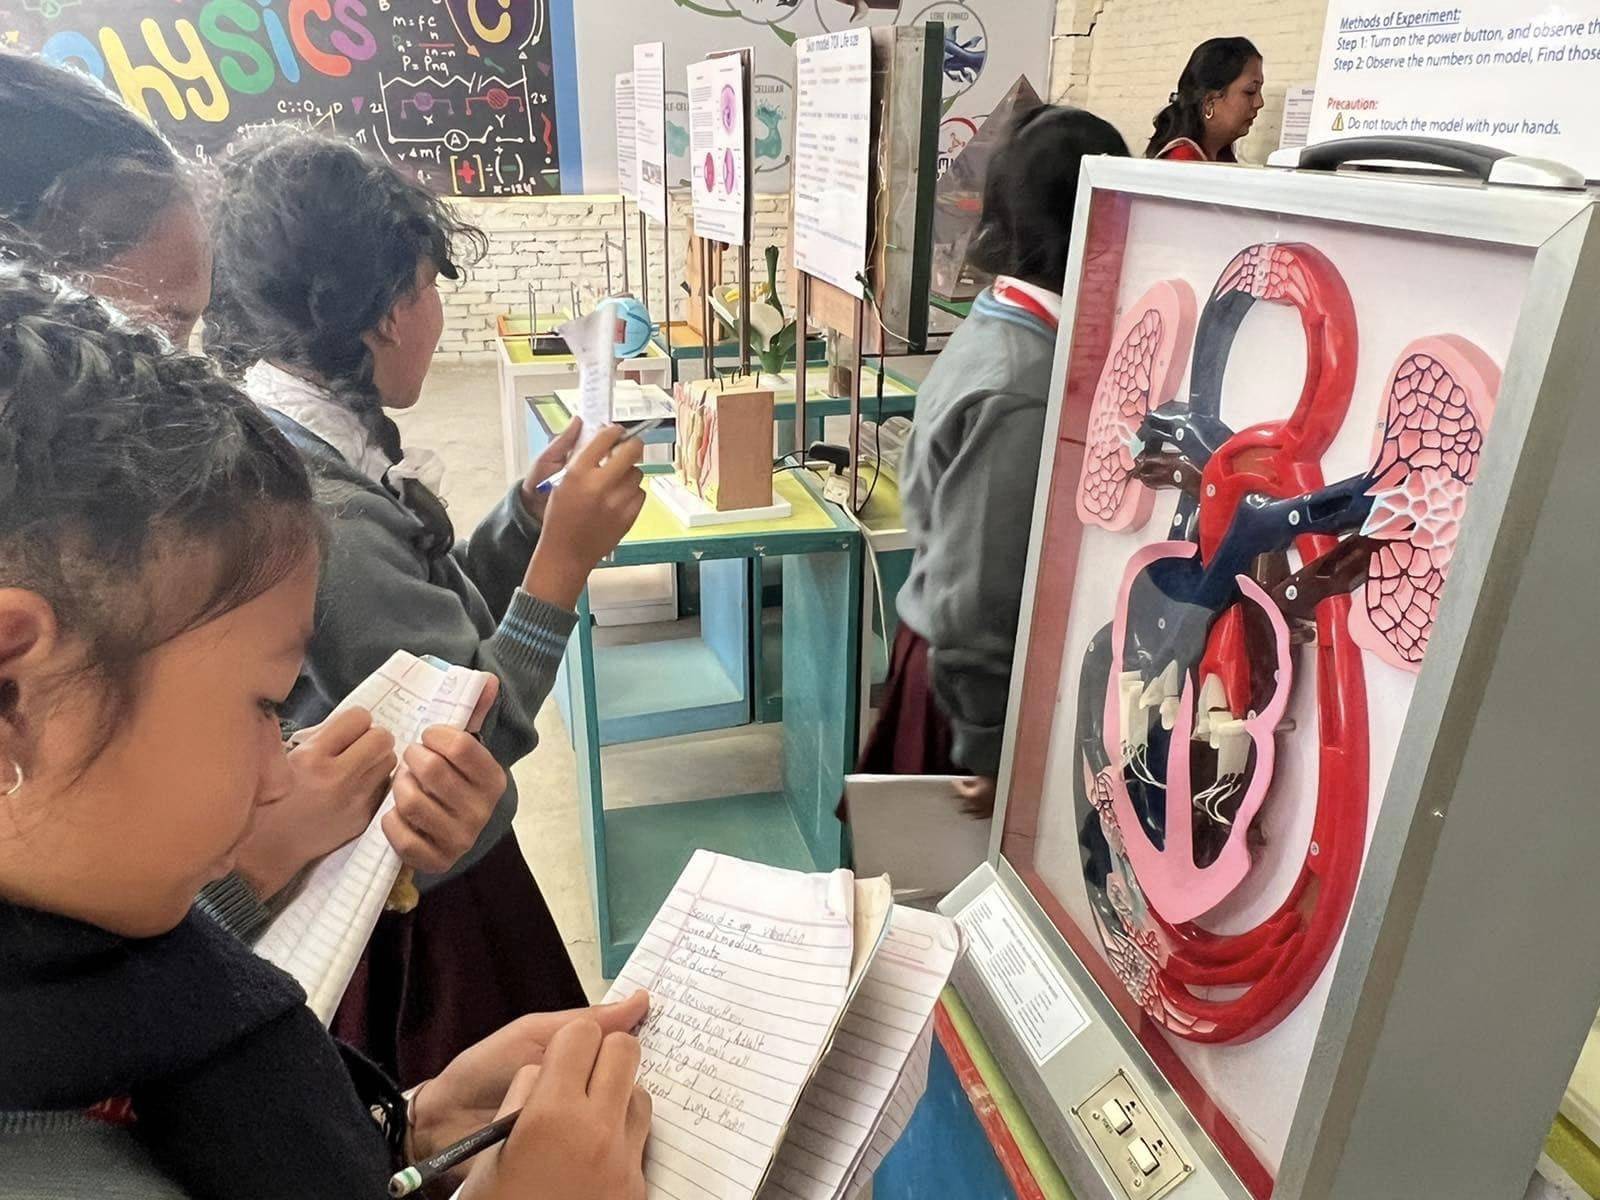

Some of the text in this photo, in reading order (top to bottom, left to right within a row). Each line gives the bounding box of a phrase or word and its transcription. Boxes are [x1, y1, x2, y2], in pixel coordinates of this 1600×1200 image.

[1340, 9, 1461, 30] Methods of Experiment:
[1337, 37, 1357, 51] Step
[1361, 36, 1368, 48] 1:
[1371, 35, 1391, 48] Turn
[1393, 38, 1405, 47] on
[1408, 33, 1425, 46] the
[1427, 32, 1461, 47] power
[1507, 23, 1531, 40] and
[1533, 22, 1584, 38] observe
[1334, 58, 1354, 71] Step
[1365, 56, 1405, 69] Observe
[1408, 54, 1425, 67] the
[1426, 53, 1473, 66] numbers
[1476, 53, 1491, 65] on
[1493, 48, 1533, 64] model,
[1537, 45, 1566, 62] Find
[1327, 97, 1379, 110] Precaution:
[1348, 117, 1561, 136] Do not touch the model with your hands.
